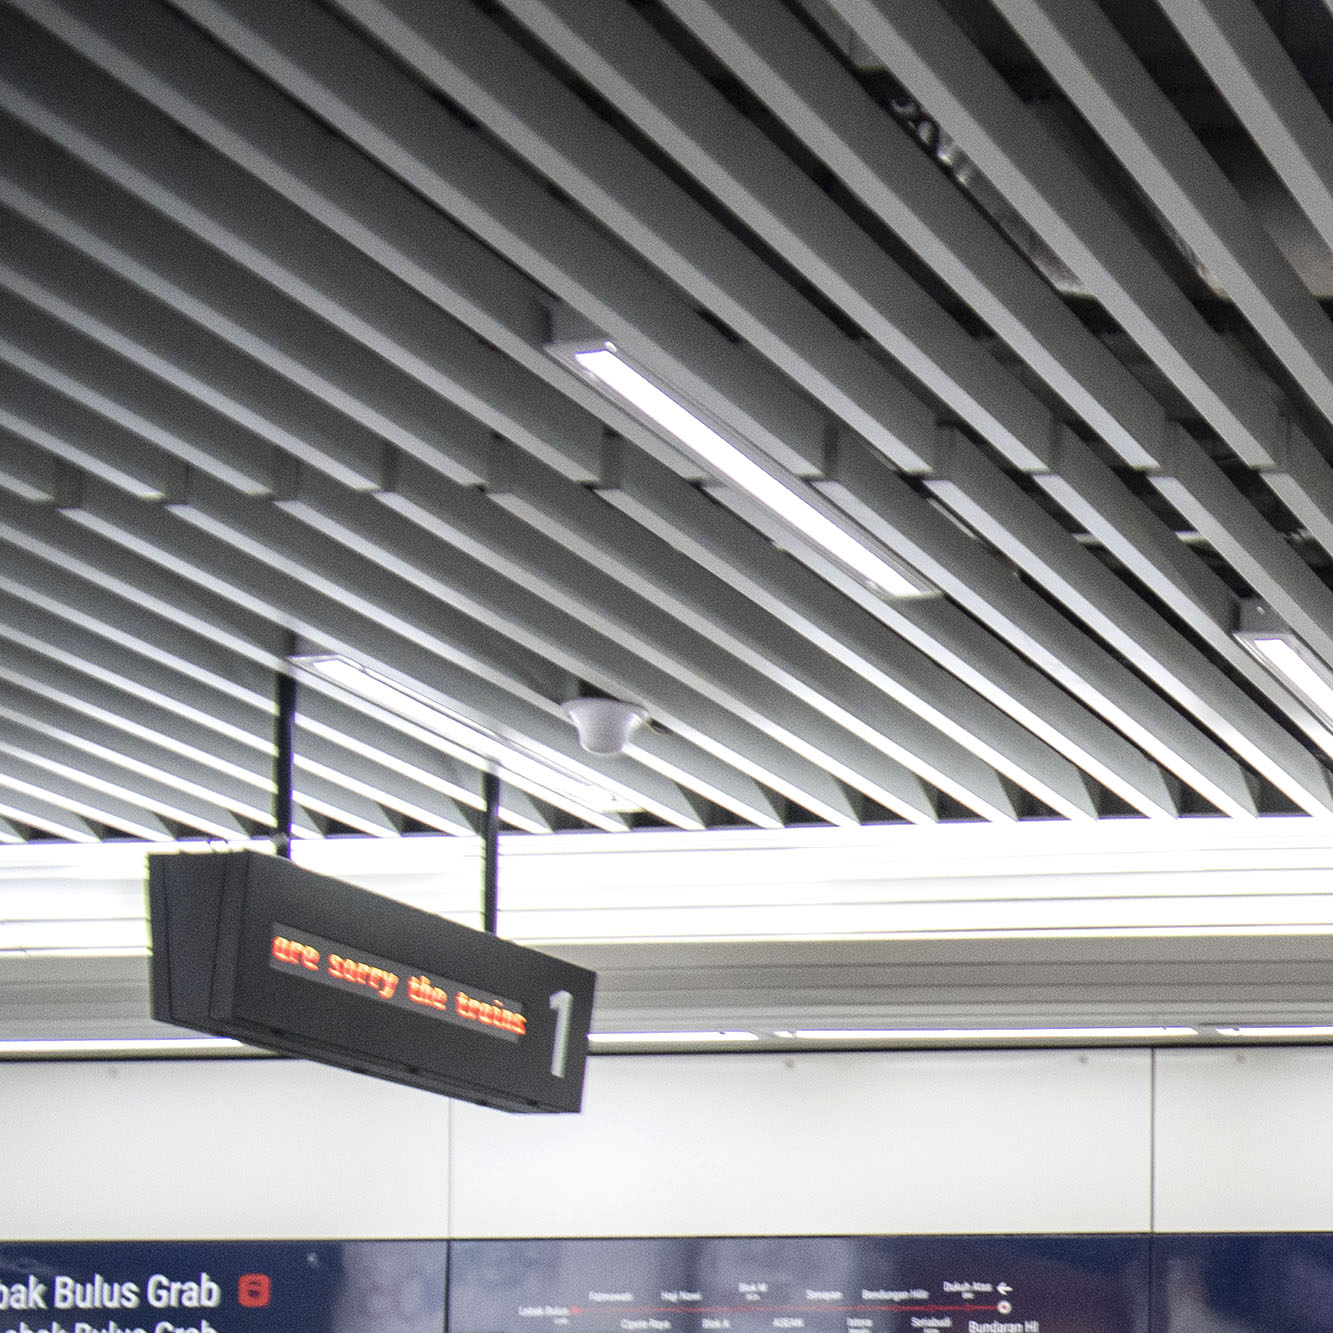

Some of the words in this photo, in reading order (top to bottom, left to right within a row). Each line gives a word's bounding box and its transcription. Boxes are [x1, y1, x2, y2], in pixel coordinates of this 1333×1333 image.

[273, 935, 320, 971] are
[328, 952, 399, 998] sorry
[408, 975, 446, 1011] the
[549, 989, 574, 1079] 1
[54, 1273, 141, 1310] Bulus
[147, 1272, 221, 1308] Grab
[968, 1320, 1024, 1333] Bundaran
[1025, 1321, 1040, 1333] HI
